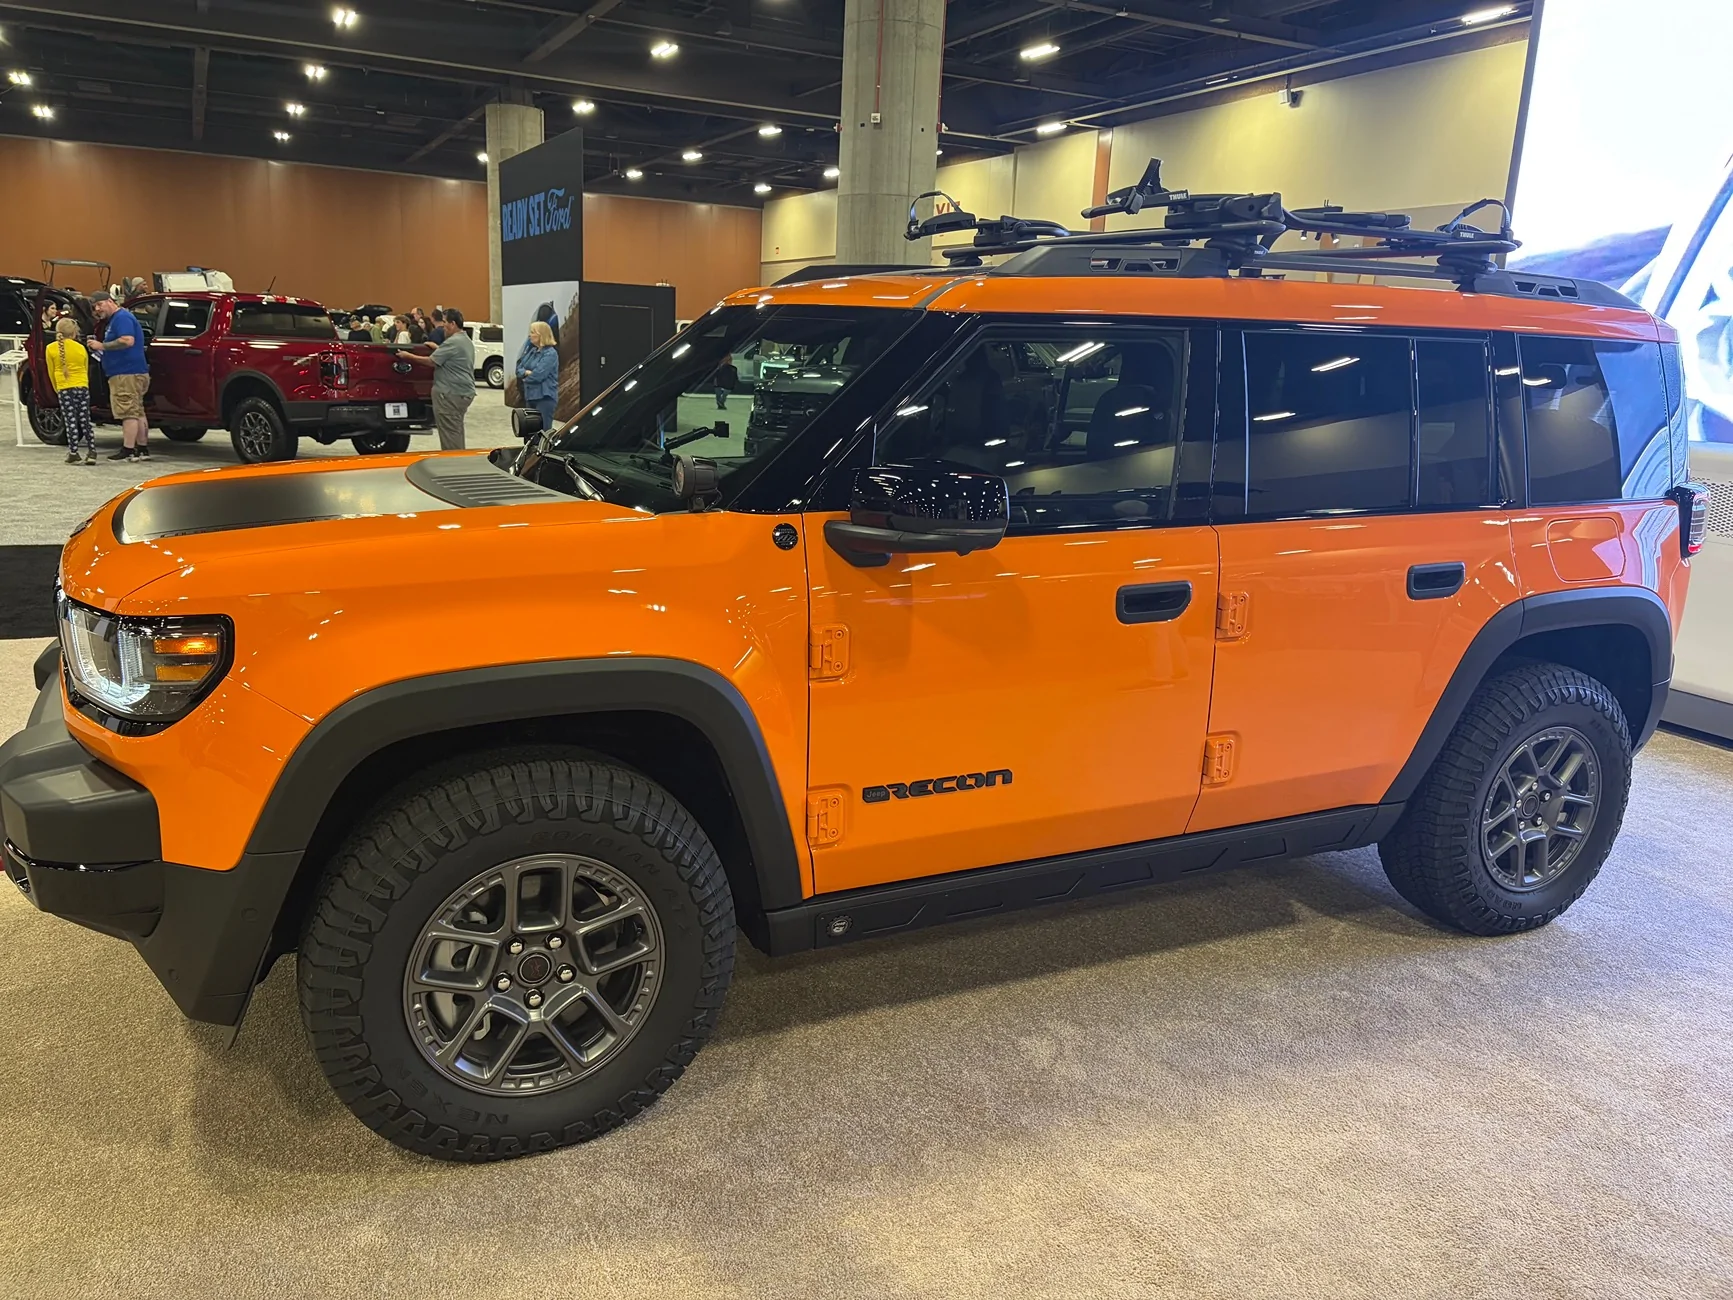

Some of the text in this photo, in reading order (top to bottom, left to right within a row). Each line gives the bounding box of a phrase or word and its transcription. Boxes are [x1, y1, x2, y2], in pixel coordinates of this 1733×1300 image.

[502, 188, 572, 242] READY SET Ford
[886, 769, 1012, 799] RECON
